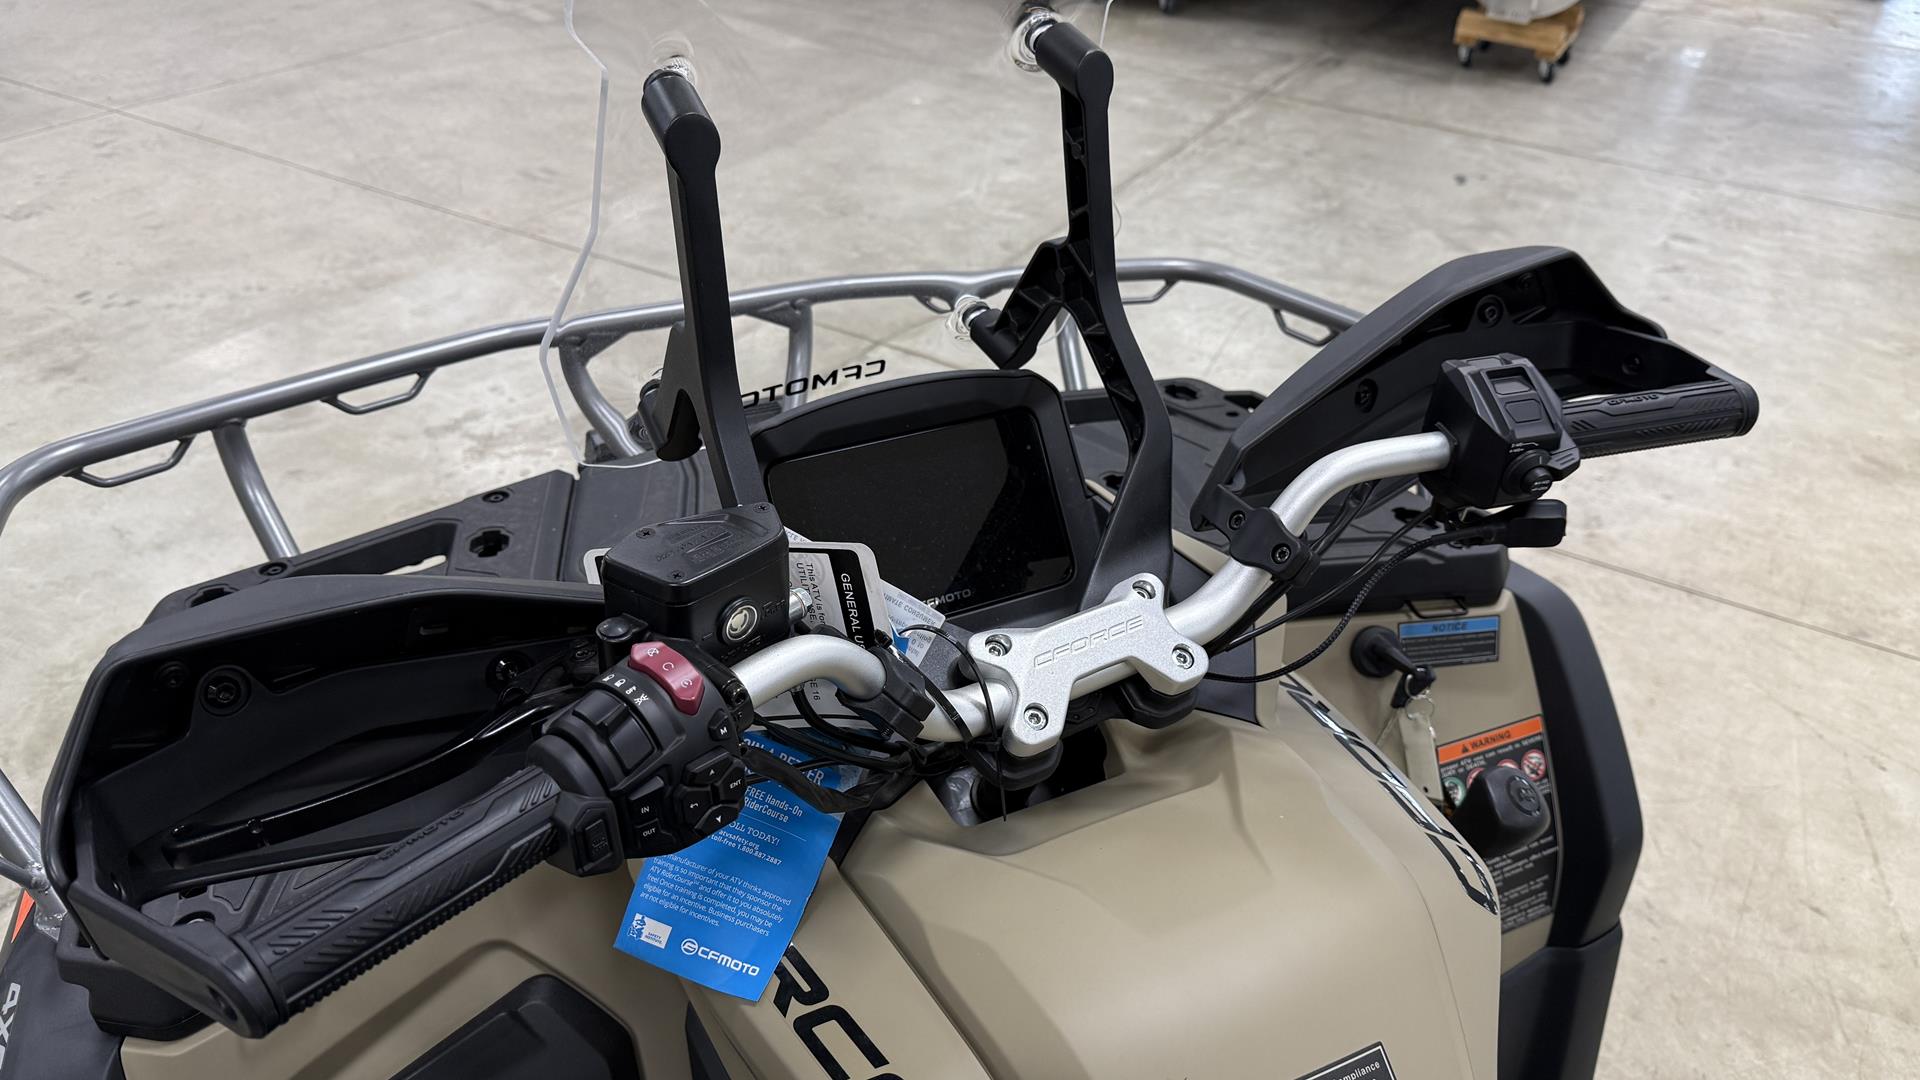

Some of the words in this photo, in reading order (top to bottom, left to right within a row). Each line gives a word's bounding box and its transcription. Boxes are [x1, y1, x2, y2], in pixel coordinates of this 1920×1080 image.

[796, 562, 811, 593] UTILIT
[805, 563, 816, 583] This
[811, 583, 821, 604] ATV
[922, 588, 972, 609] FMOTO
[841, 573, 861, 633] GENERAL
[853, 635, 866, 650] US
[1432, 622, 1468, 633] NOTICE
[1034, 615, 1143, 668] CFORCE
[625, 686, 637, 695] OFF
[812, 690, 821, 701] 16
[720, 727, 728, 735] M
[1471, 730, 1512, 748] WARNING
[730, 778, 742, 789] ENT
[641, 806, 650, 814] IN
[744, 785, 765, 801] FREE
[765, 794, 803, 817] Hands-On
[744, 797, 789, 823] RiderCourse
[642, 827, 656, 837] OUT
[711, 834, 737, 848] toll-free
[718, 830, 760, 851] atvsafety.org
[728, 821, 746, 832] OLL
[747, 826, 780, 846] TODAY!
[649, 865, 662, 875] ATV
[698, 885, 712, 893] and
[711, 889, 727, 900] offer
[739, 900, 752, 910] you
[751, 905, 784, 923] absolutely
[687, 871, 719, 886] important
[718, 882, 732, 892] that
[731, 886, 747, 898] they
[746, 894, 772, 908] sponsor
[771, 902, 783, 913] the
[714, 871, 730, 881] your
[730, 876, 743, 886] ATV
[742, 881, 763, 894] thinks
[761, 890, 792, 906] approved
[659, 879, 675, 888] Once
[674, 885, 697, 900] training
[703, 896, 737, 914] completed,
[736, 909, 750, 919] you
[750, 914, 764, 926] may
[764, 919, 773, 928] be
[661, 889, 671, 897] for
[679, 897, 708, 912] incentive.
[707, 907, 736, 923] Business
[734, 919, 769, 937] purchasers
[679, 905, 689, 914] for
[688, 911, 720, 927] incentives.
[697, 946, 760, 977] CFMOTO
